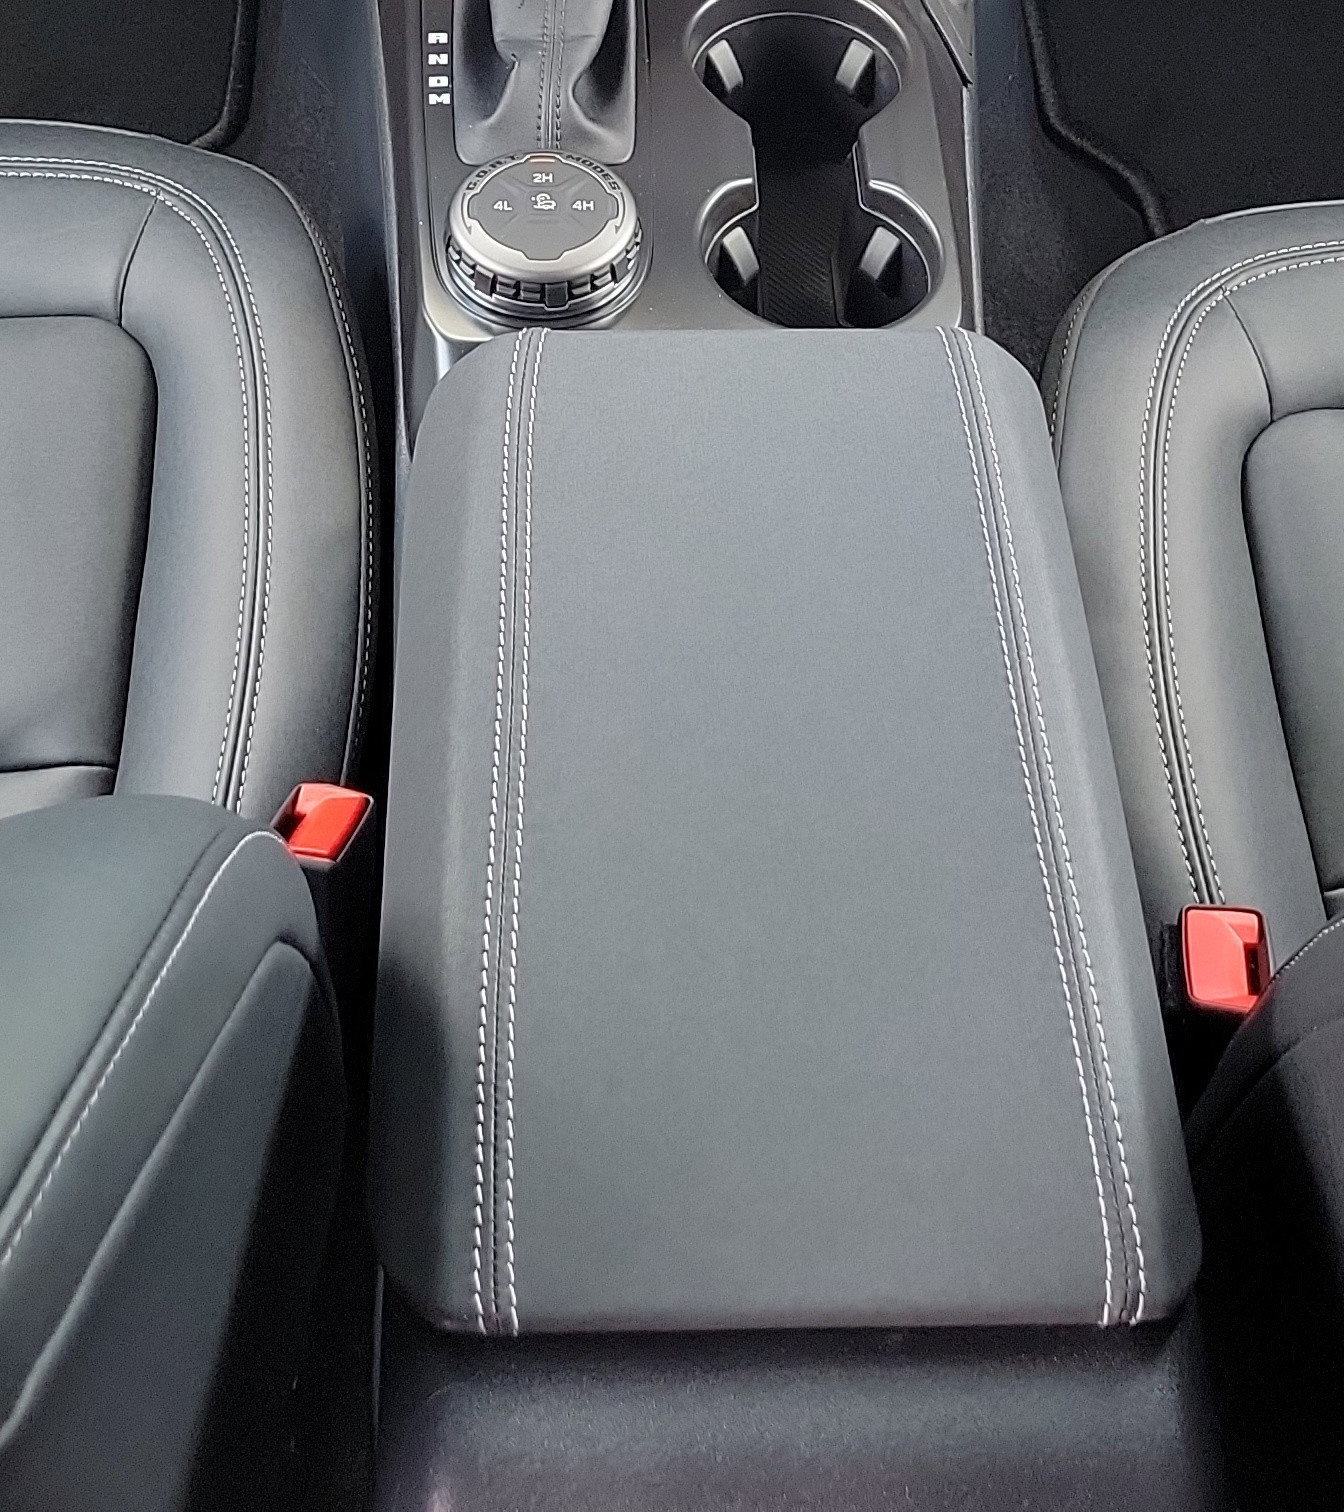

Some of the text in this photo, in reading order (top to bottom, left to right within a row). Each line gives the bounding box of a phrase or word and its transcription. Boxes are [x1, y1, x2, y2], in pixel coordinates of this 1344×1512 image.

[428, 32, 449, 44] R
[428, 53, 449, 66] N
[428, 76, 449, 88] D
[428, 93, 451, 105] M
[532, 172, 554, 184] 2H
[565, 154, 622, 191] MODES
[493, 200, 514, 211] 4L
[571, 200, 595, 211] 4H
